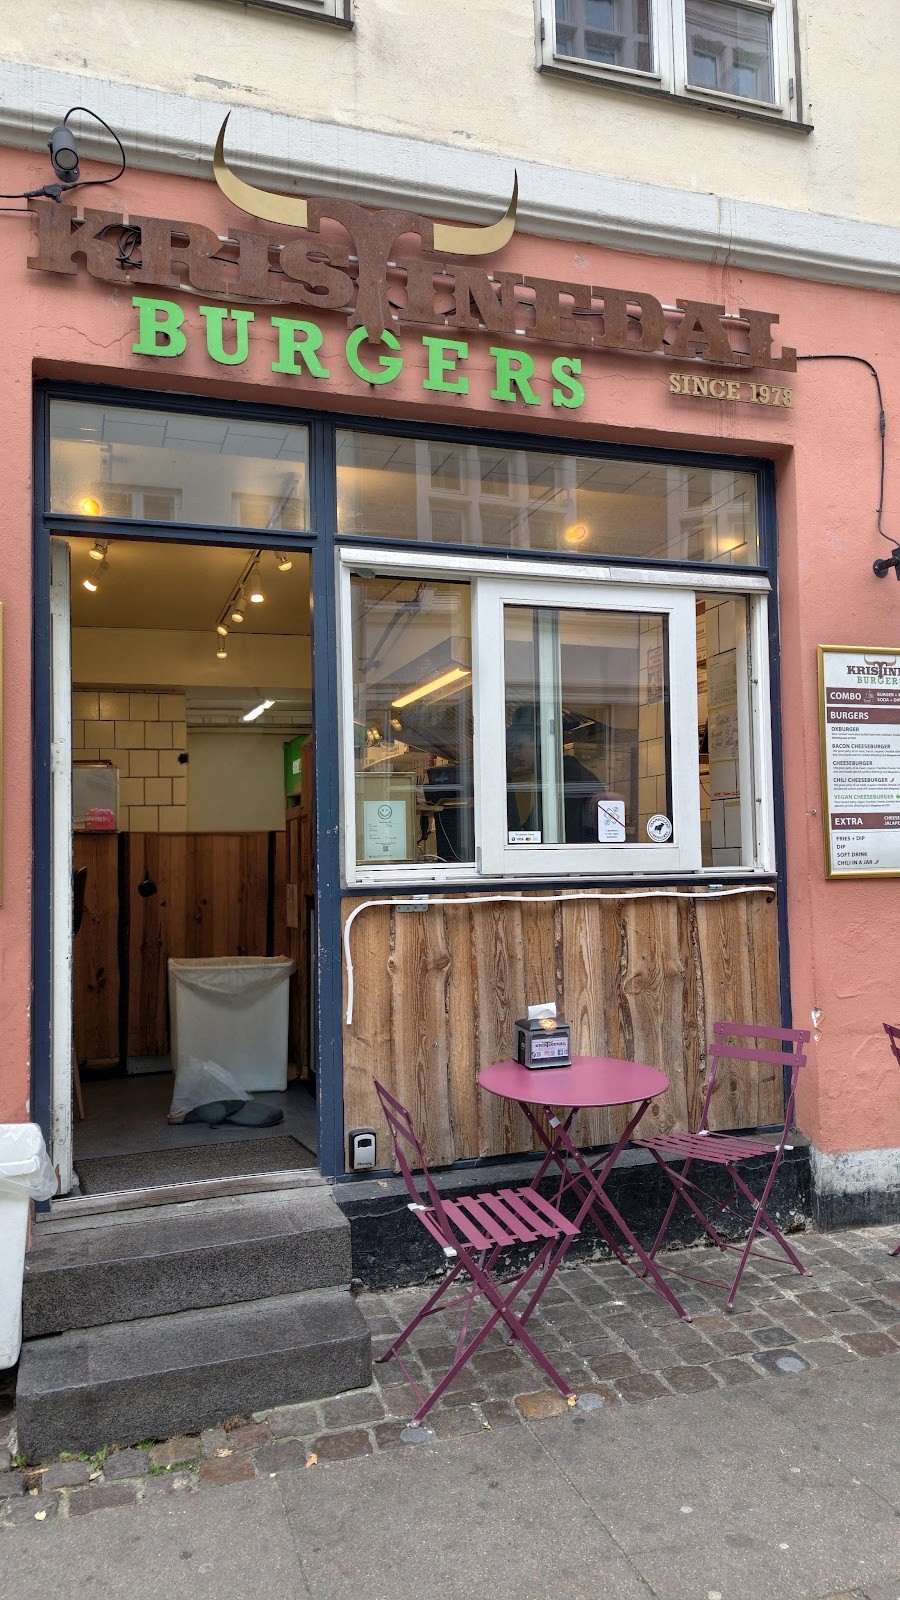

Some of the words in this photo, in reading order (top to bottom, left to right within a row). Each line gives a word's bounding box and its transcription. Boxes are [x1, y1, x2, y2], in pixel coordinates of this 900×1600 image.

[27, 197, 797, 373] KRISTINEDAL
[132, 296, 587, 410] BURGERS
[669, 373, 741, 400] SINCE
[750, 383, 793, 408] 1978
[857, 676, 900, 685] BURGER
[830, 692, 862, 700] COMBO
[830, 711, 869, 720] BURGERS
[834, 817, 863, 826] EXTRA
